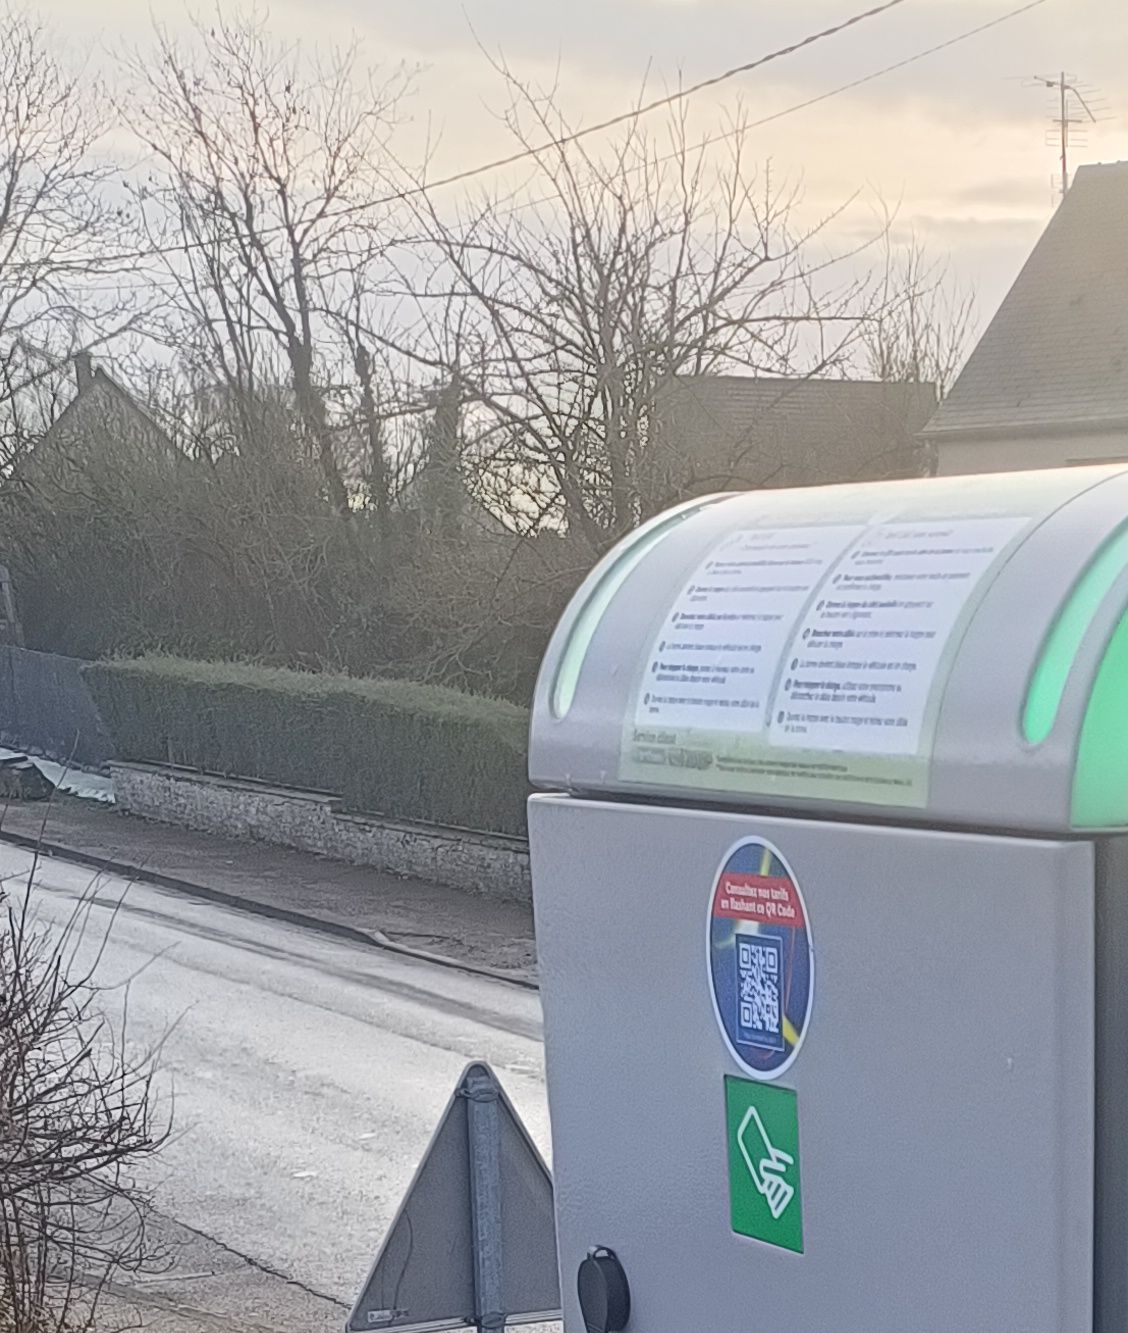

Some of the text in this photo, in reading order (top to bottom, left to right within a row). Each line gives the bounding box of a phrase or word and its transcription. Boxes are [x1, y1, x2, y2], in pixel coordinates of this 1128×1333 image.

[758, 889, 770, 900] nos
[771, 888, 788, 901] tarifs
[765, 902, 776, 918] QR
[777, 904, 795, 918] Code
